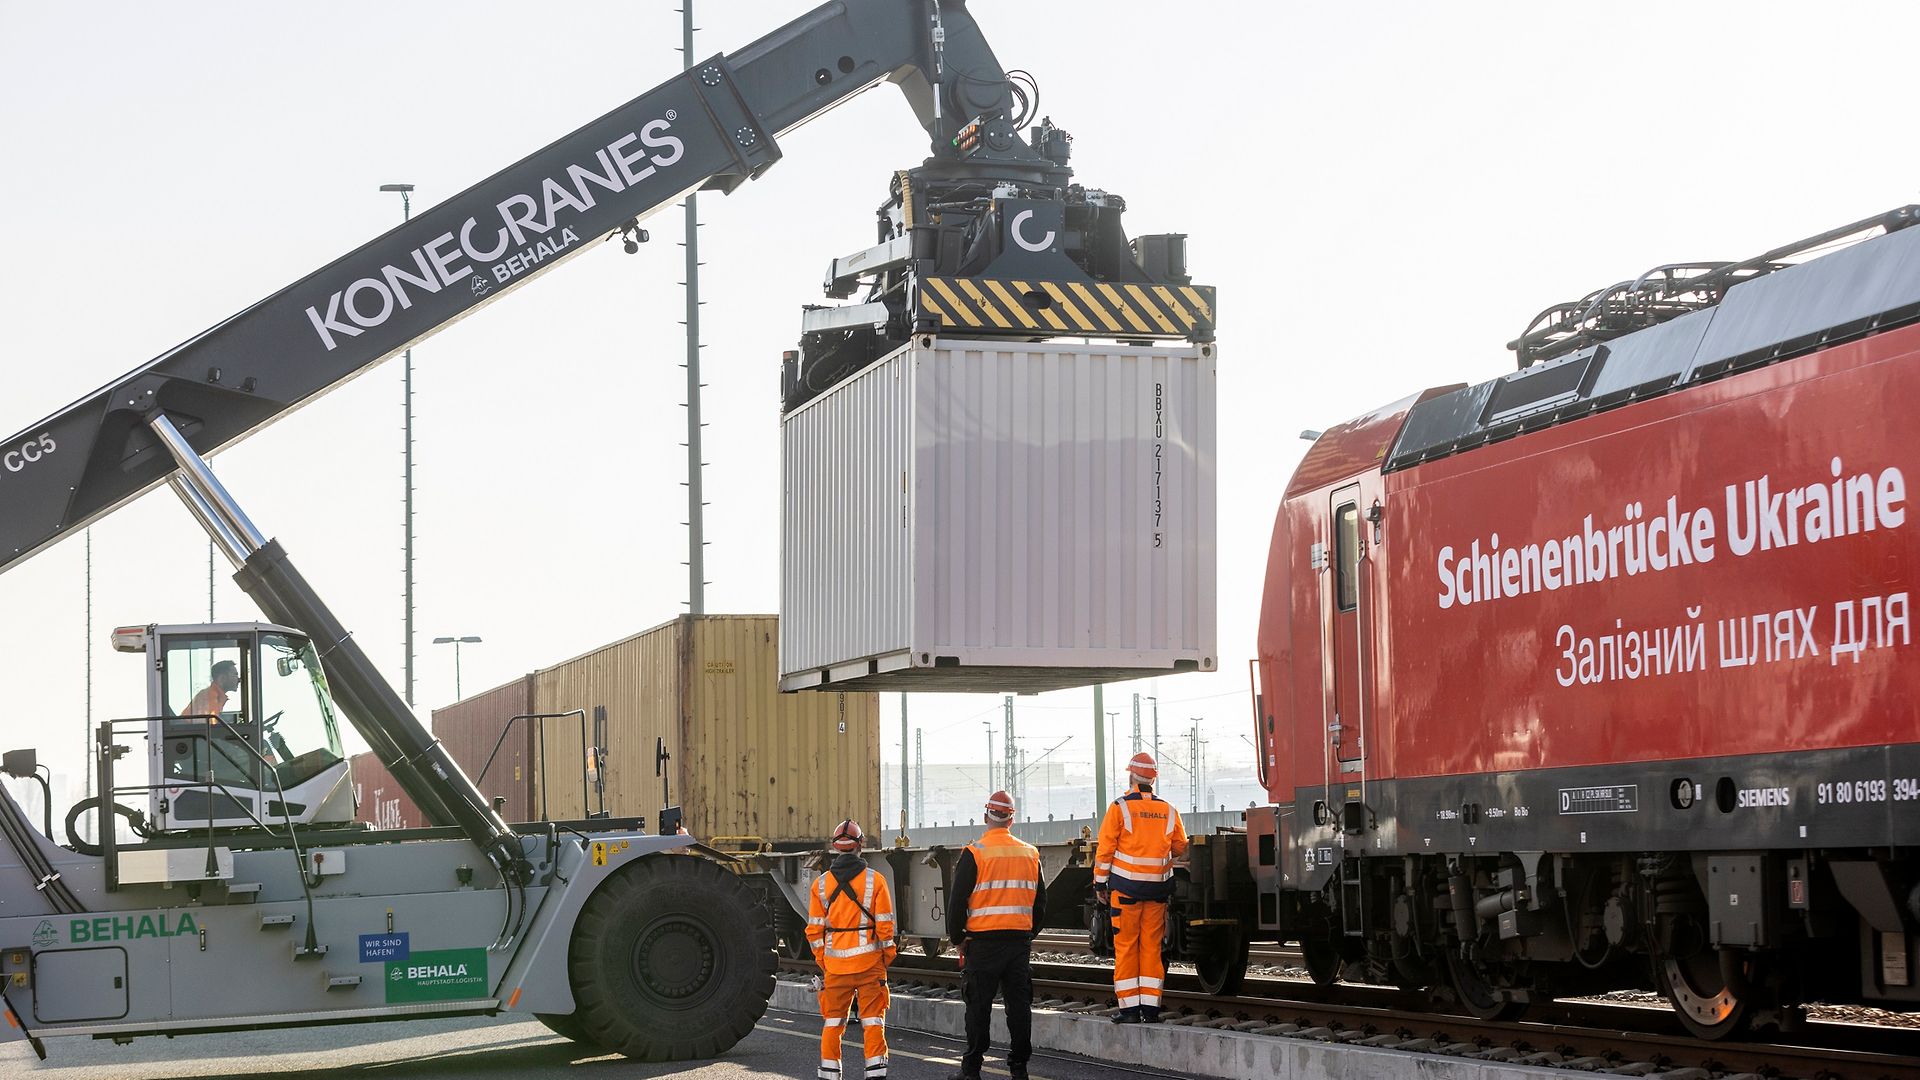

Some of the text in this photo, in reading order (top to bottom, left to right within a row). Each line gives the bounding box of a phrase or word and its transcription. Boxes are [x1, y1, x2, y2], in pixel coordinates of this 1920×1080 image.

[491, 229, 580, 284] BEHALA
[4, 432, 56, 472] CC5
[1438, 456, 1906, 609] Schienenbrücke Ukraine
[1555, 592, 1911, 687] Залізний шлях для
[1738, 787, 1790, 808] SIEMENS
[1818, 783, 1833, 804] 91
[1836, 782, 1852, 803] 80
[1855, 780, 1886, 802] 6193
[69, 912, 199, 944] BEHALA
[365, 940, 380, 948] WIR
[366, 948, 395, 957] HAFEN!
[407, 964, 468, 979] BEHALA
